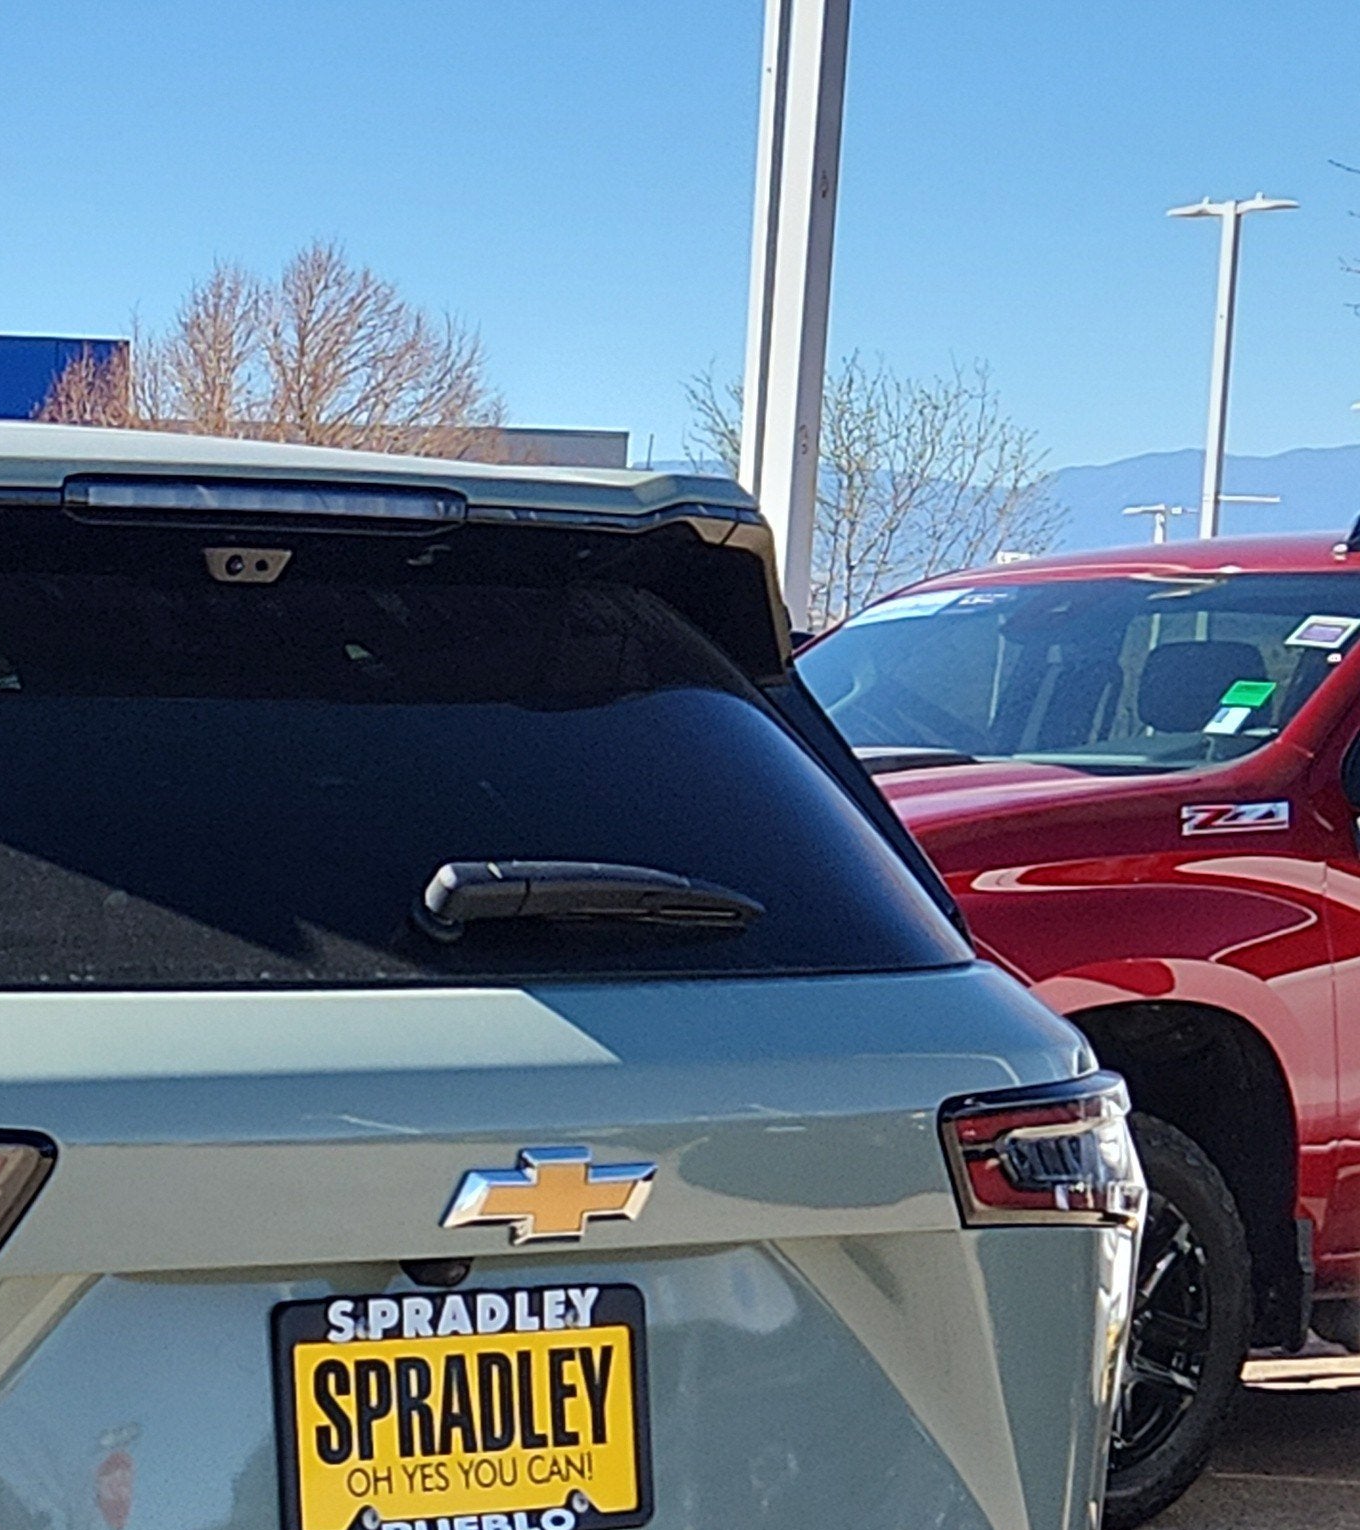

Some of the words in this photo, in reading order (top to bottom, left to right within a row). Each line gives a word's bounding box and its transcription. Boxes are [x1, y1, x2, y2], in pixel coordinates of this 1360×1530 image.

[326, 1286, 599, 1343] SPRADLEY
[312, 1345, 615, 1466] SPRADLEY
[347, 1465, 394, 1498] OH
[402, 1460, 451, 1493] YES
[457, 1456, 519, 1489] YOU
[526, 1451, 595, 1484] CAN!
